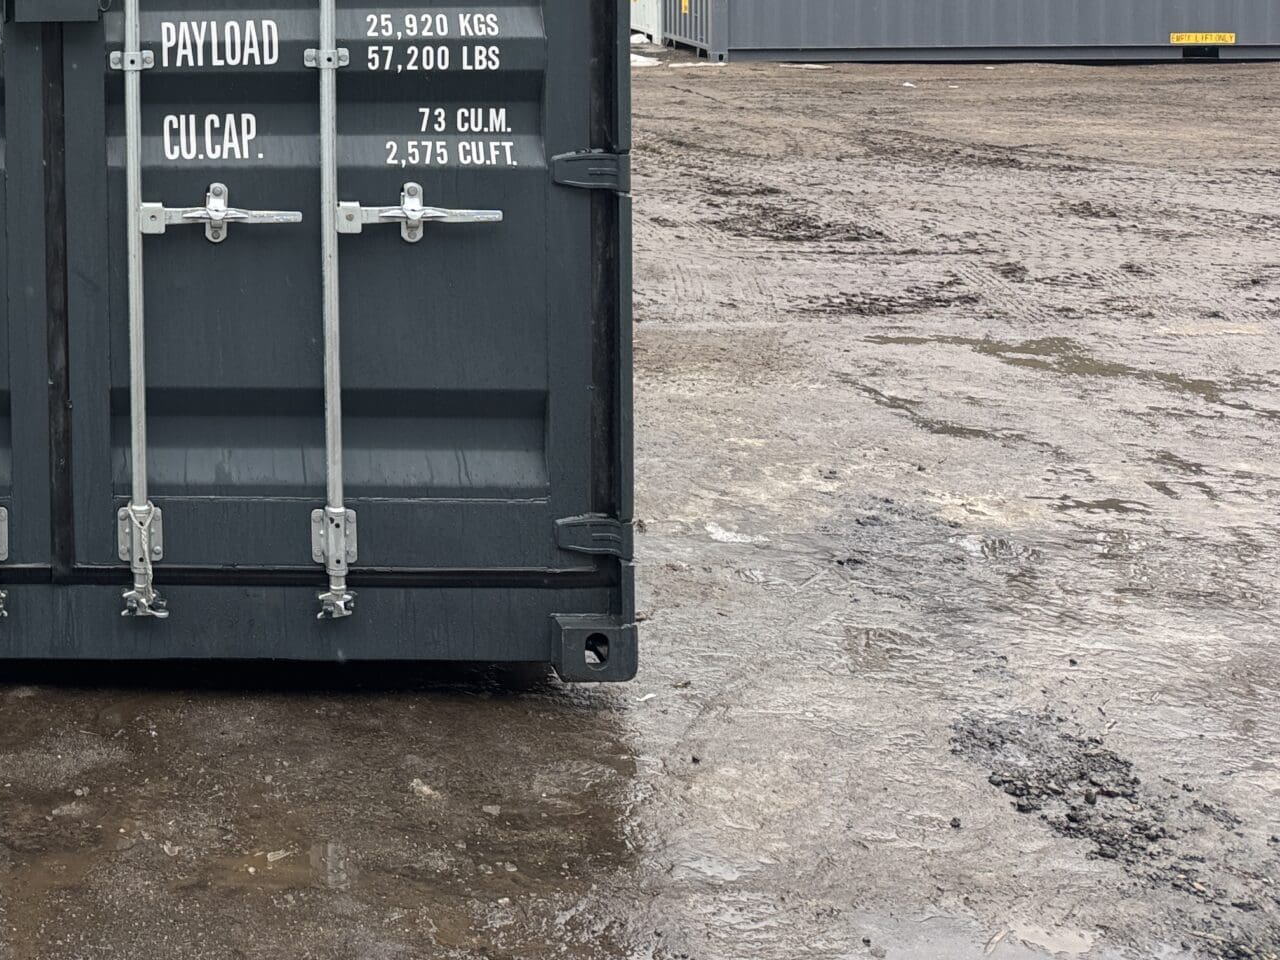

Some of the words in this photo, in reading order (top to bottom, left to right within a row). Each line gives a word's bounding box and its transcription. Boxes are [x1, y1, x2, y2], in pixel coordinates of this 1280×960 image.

[161, 19, 279, 67] PAYLOAD
[366, 13, 448, 38] 25,920
[459, 13, 499, 36] KGS
[368, 46, 449, 72] 57,200
[462, 46, 500, 70] LBS
[163, 113, 264, 159] CU.CAP.
[418, 108, 446, 132] 73
[457, 108, 512, 133] CU.M.
[385, 141, 448, 167] 2,575
[459, 141, 518, 166] CU.FT.
